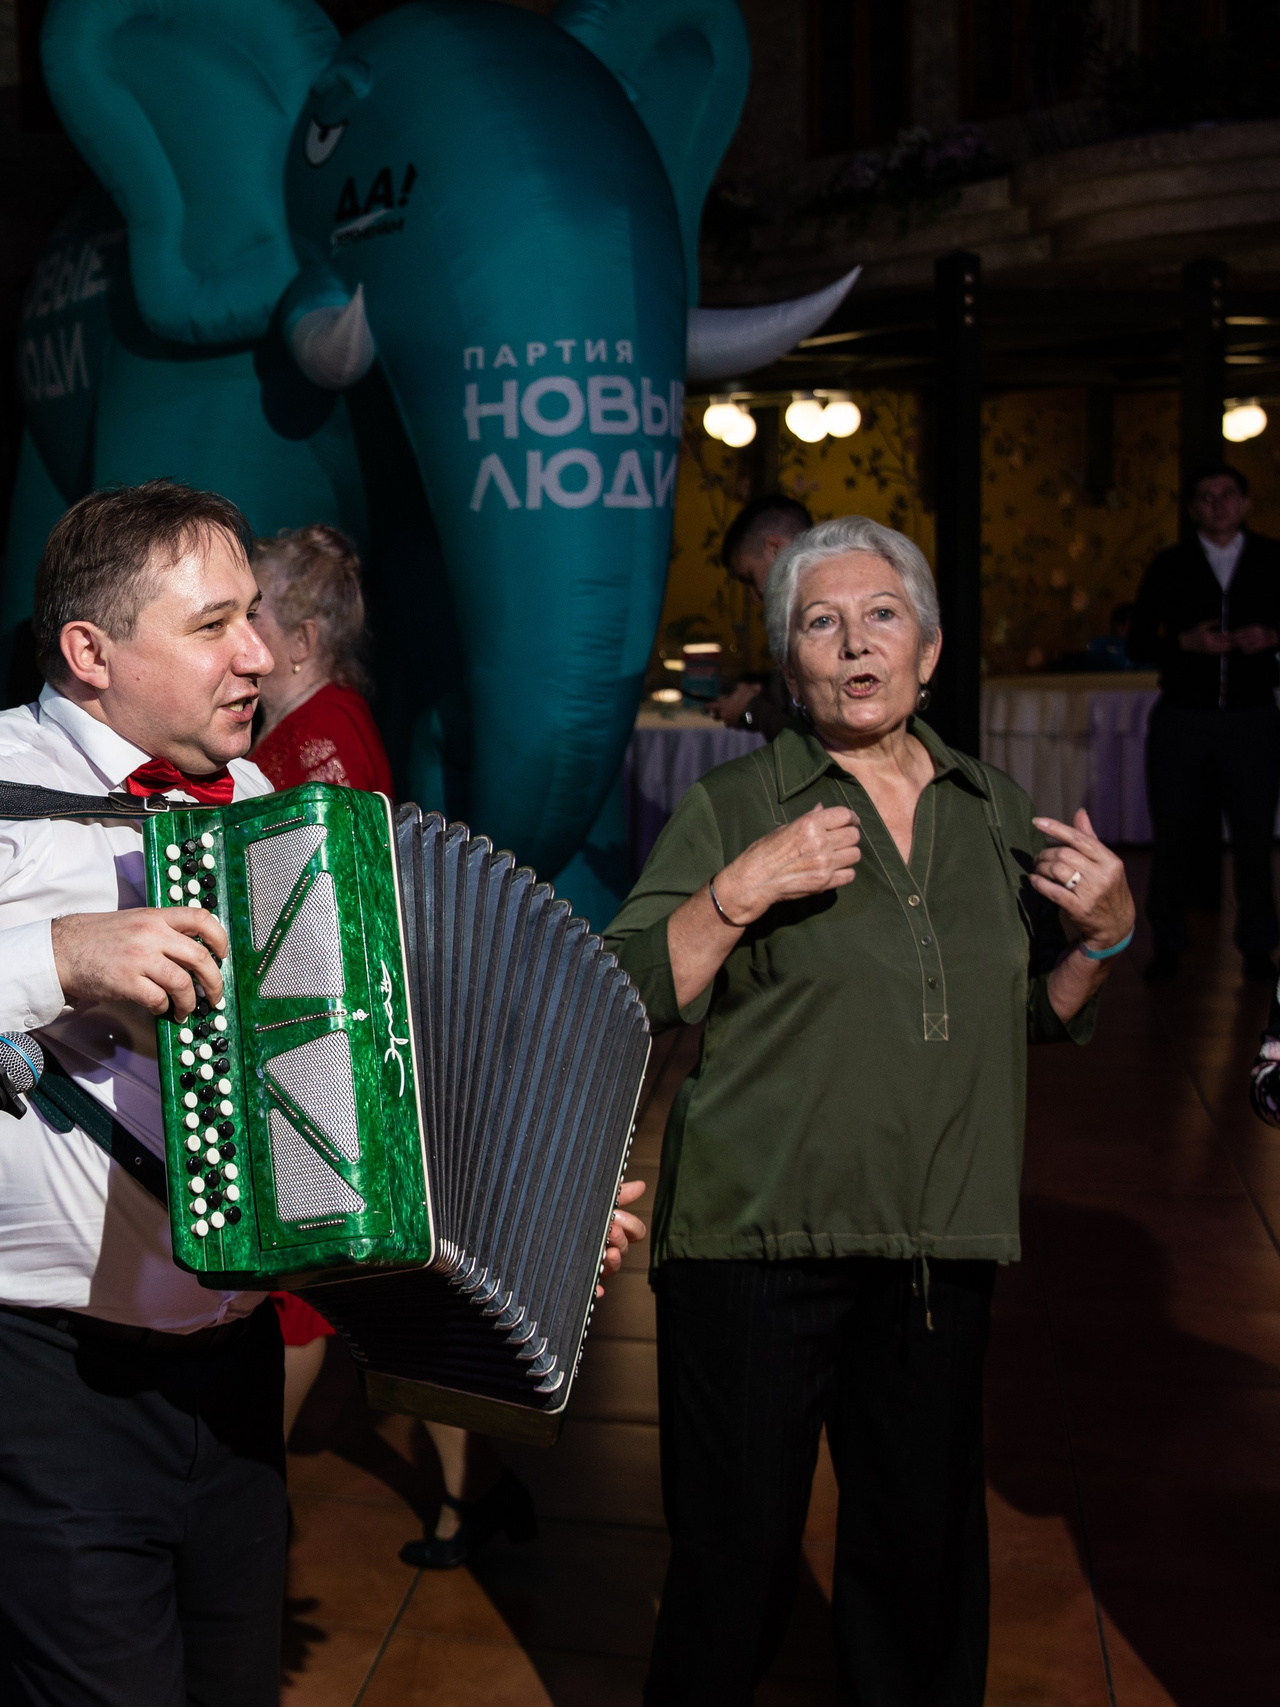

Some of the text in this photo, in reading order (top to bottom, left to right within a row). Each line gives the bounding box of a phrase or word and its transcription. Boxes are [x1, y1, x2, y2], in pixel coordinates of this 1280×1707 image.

[336, 163, 417, 221] ДА!
[463, 338, 634, 371] ПАРТИЯ
[463, 374, 685, 441] НОВЫ
